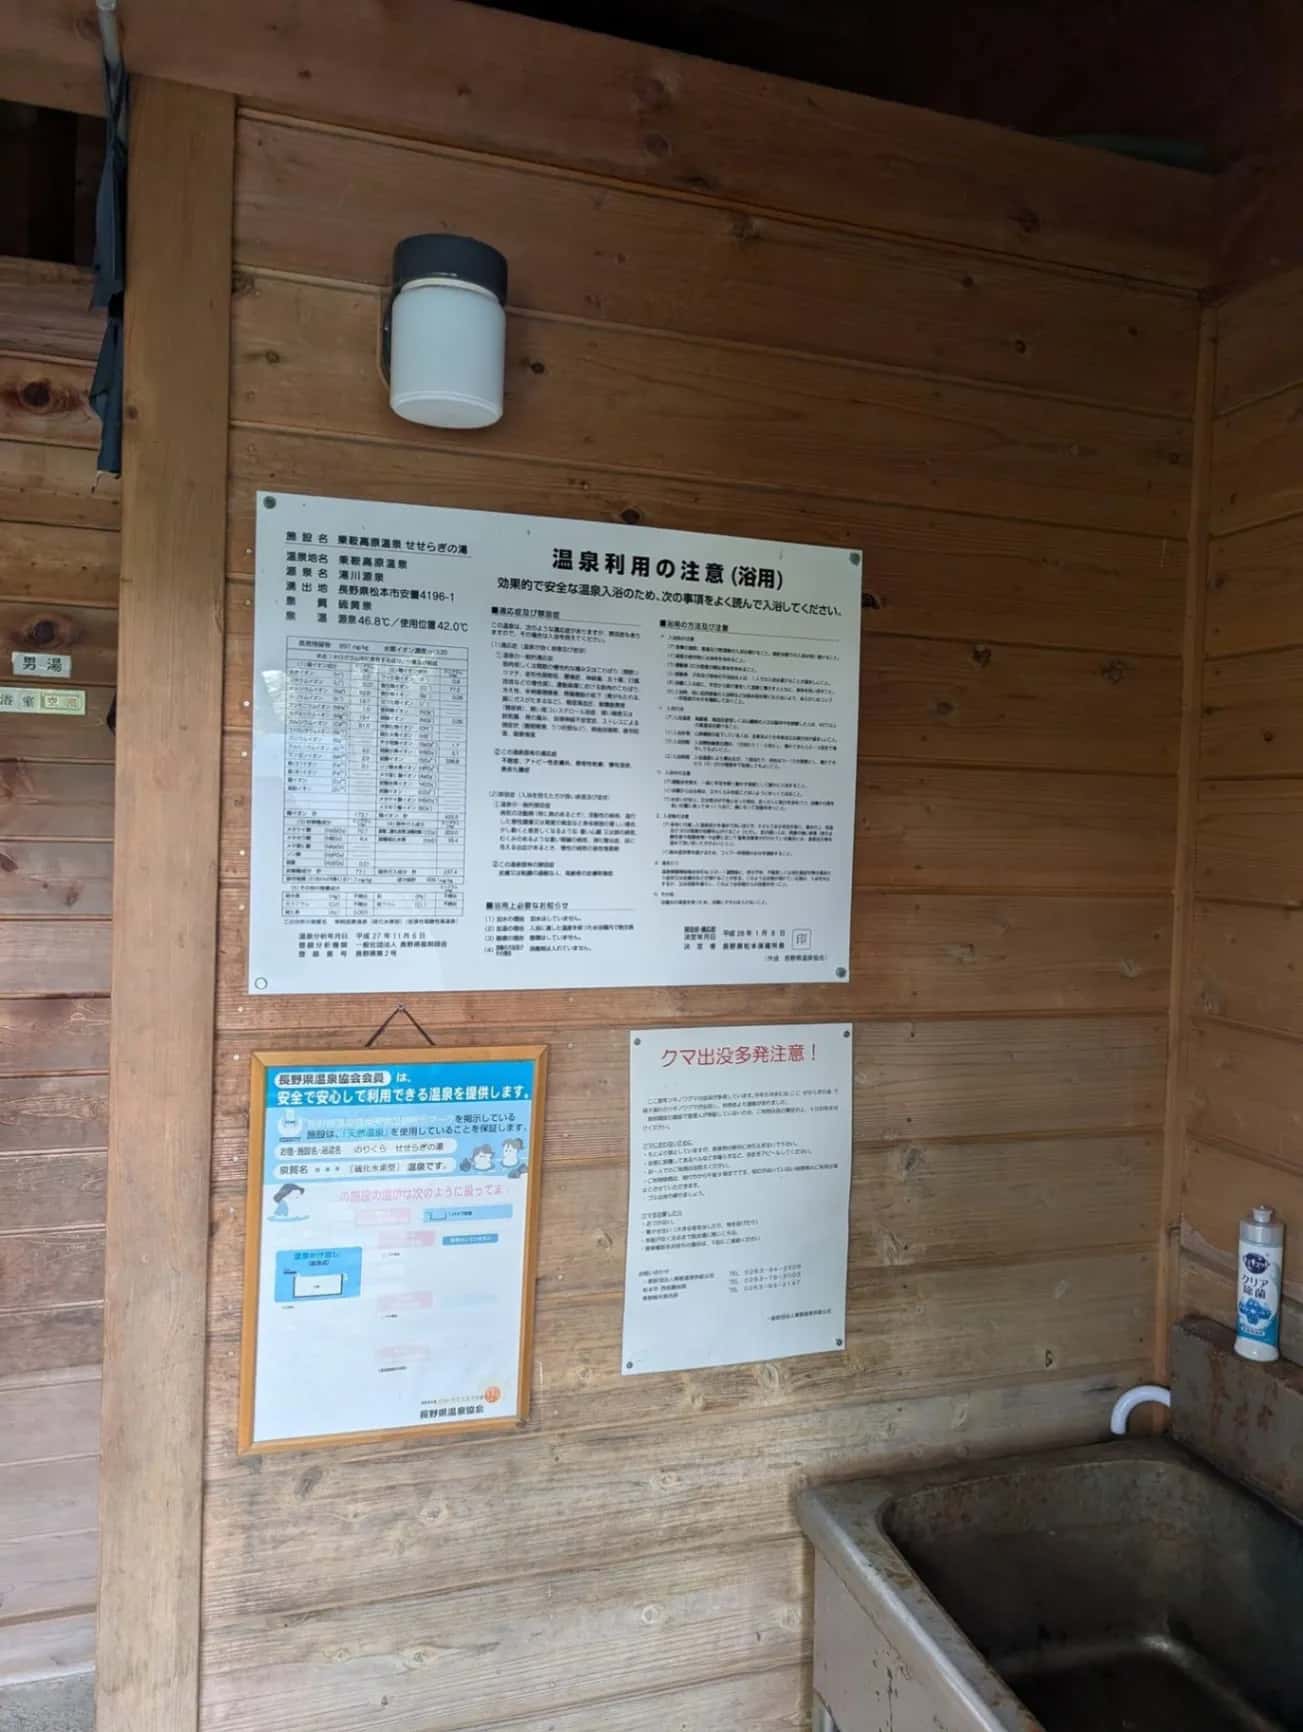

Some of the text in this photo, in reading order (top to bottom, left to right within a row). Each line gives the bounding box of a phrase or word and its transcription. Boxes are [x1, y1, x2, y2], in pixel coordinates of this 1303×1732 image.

[406, 540, 468, 555] せせらぎの湯
[23, 656, 62, 672] 男湯
[661, 1044, 816, 1068] クマ出没多発注意！
[278, 1072, 385, 1086] 長野県温泉協会会員
[276, 1085, 529, 1106] 安全で安心して利用できる温泉を提供します。
[1242, 1274, 1270, 1289] クリア
[1242, 1284, 1266, 1300] 除菌
